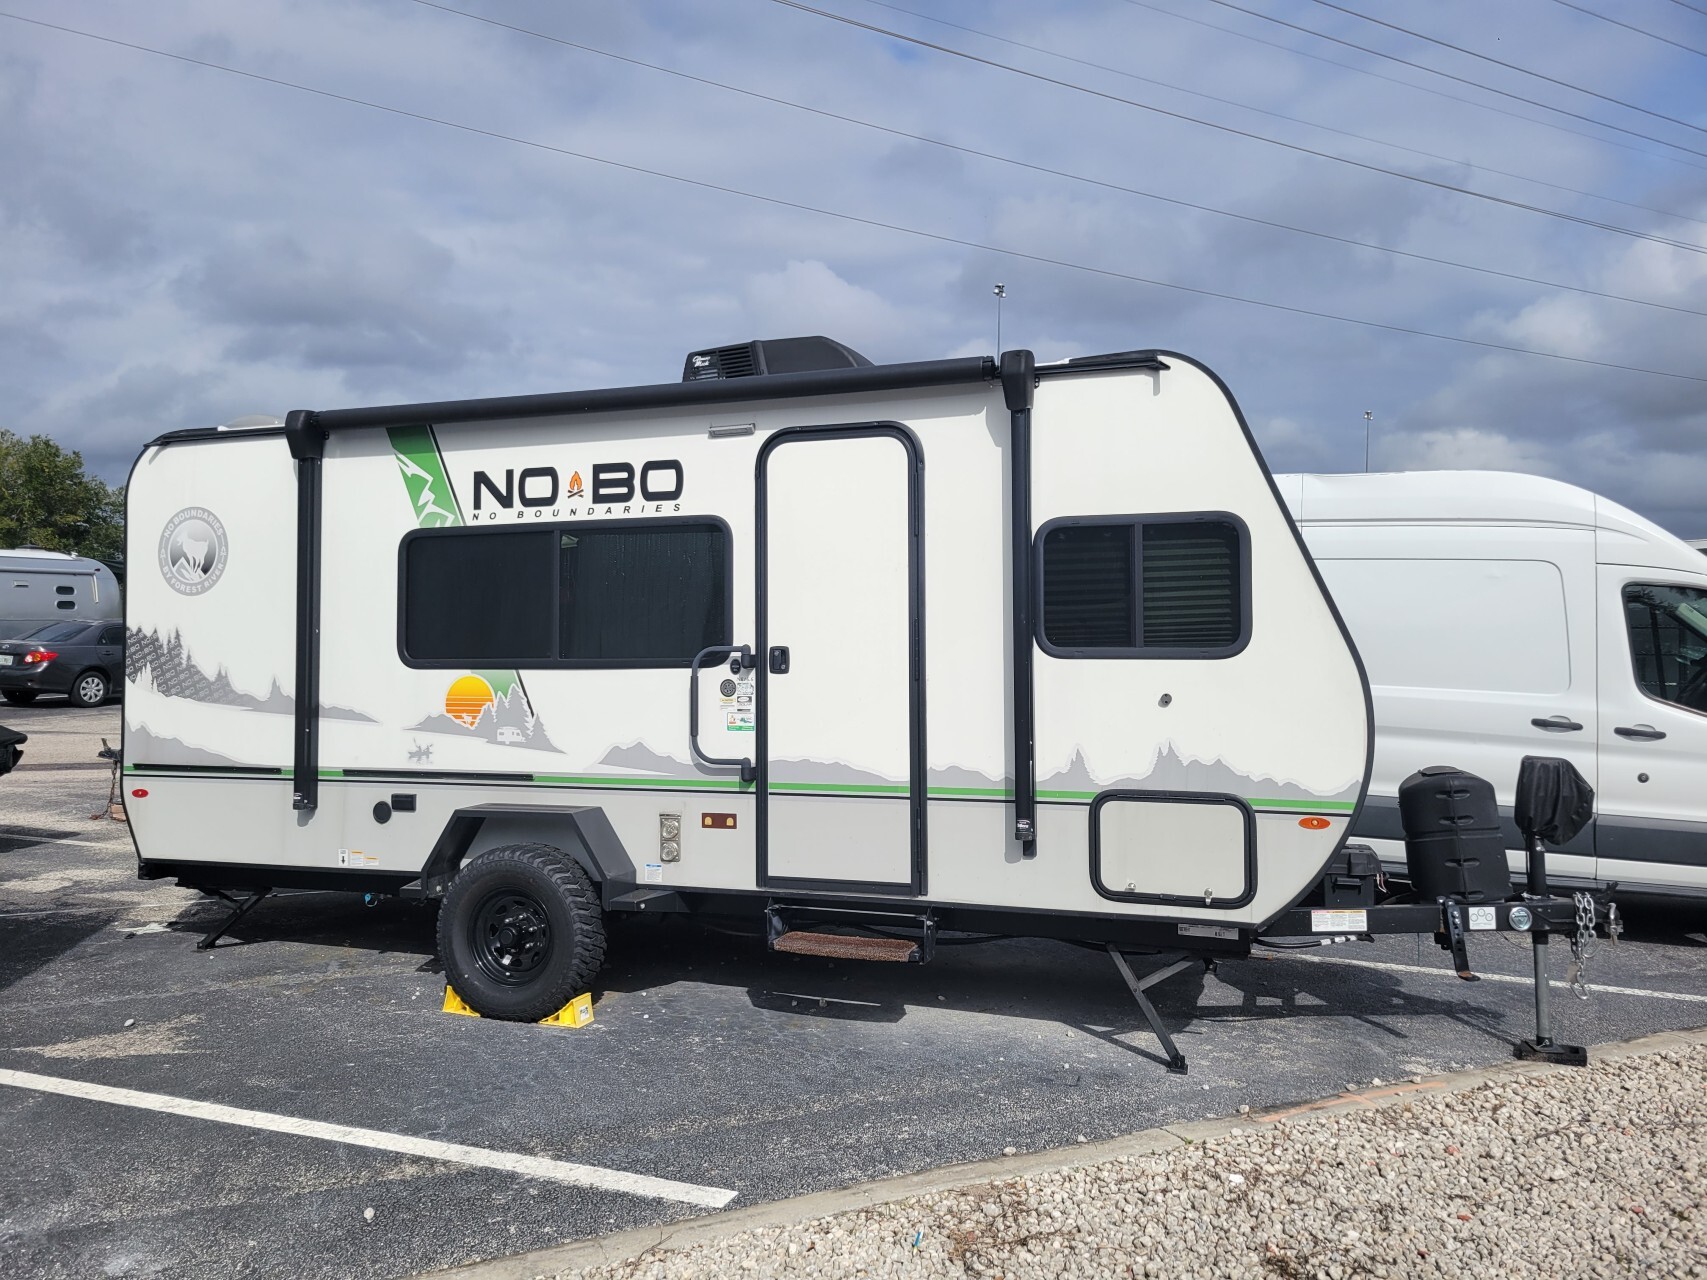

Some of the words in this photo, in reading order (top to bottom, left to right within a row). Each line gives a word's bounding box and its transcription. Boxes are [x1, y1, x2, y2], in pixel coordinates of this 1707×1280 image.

[473, 466, 559, 510] NO
[592, 459, 684, 504] BO
[164, 524, 174, 538] NO
[174, 510, 224, 536] BOUNDARIES
[472, 512, 497, 521] NO
[517, 503, 681, 518] BOUNDARIES
[162, 567, 172, 578] BY
[170, 579, 202, 593] FOREST
[204, 564, 224, 588] RIVER
